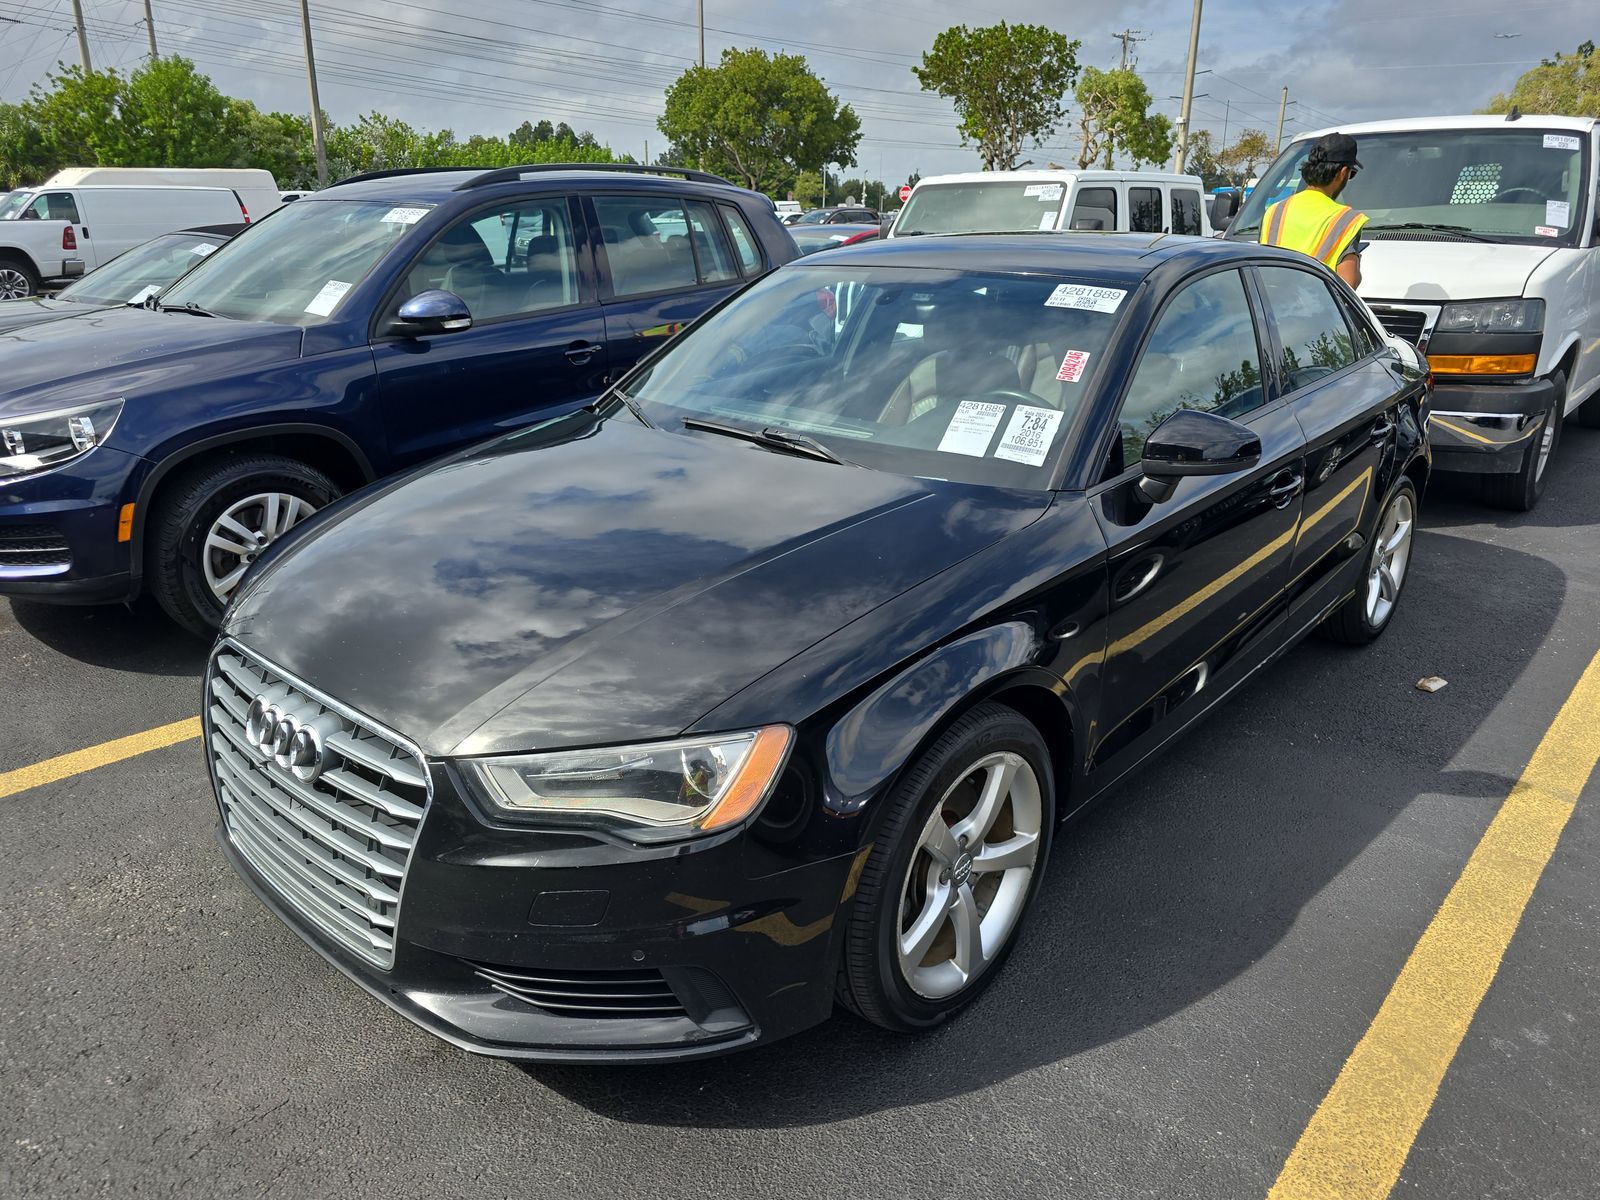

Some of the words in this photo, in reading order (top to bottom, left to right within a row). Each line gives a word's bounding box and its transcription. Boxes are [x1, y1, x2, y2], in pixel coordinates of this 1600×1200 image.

[1059, 286, 1122, 300] 4281889
[1058, 351, 1084, 381] 5094246
[960, 402, 1005, 414] 4281889
[1021, 415, 1048, 432] 7:84
[1019, 429, 1042, 440] 2016
[1010, 435, 1044, 448] 106,951
